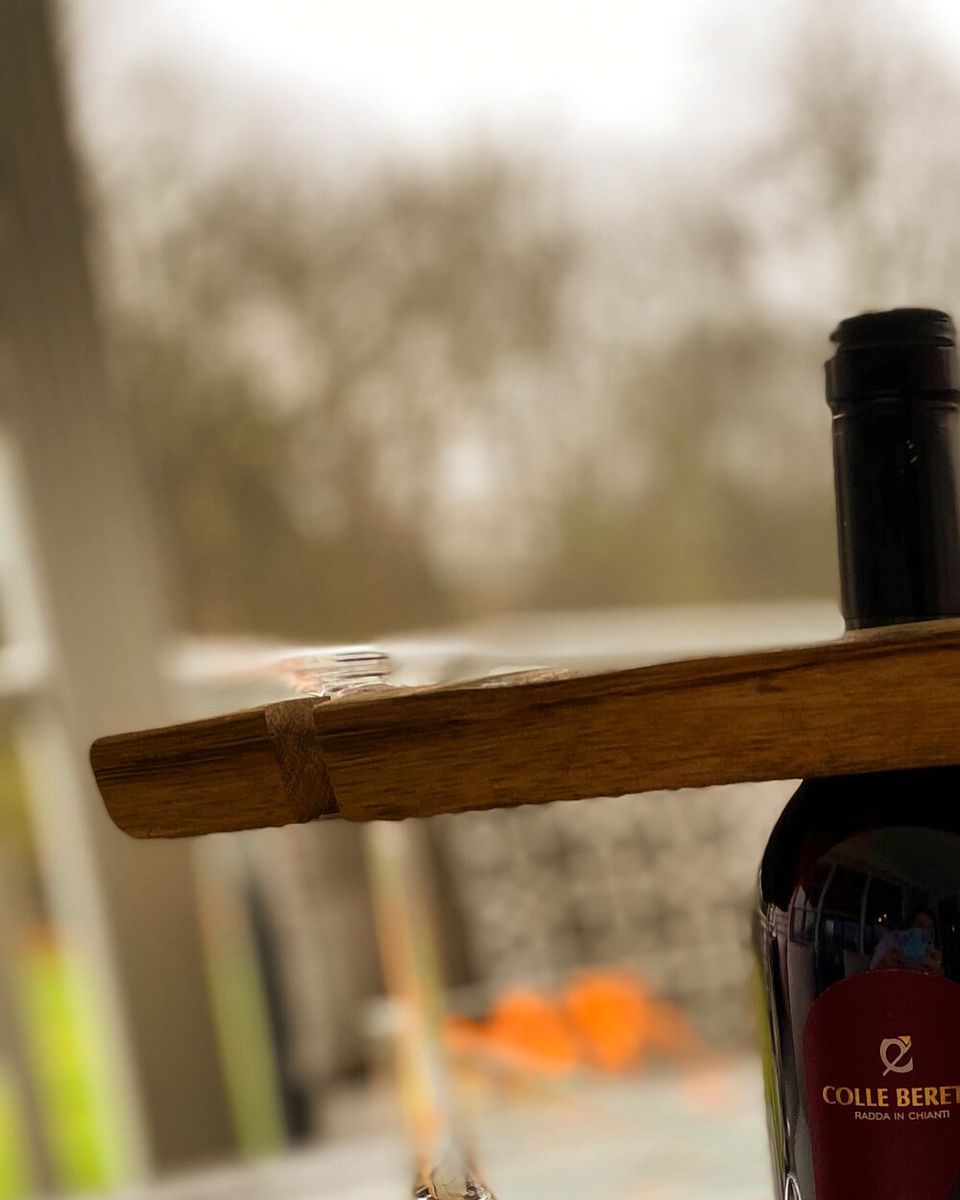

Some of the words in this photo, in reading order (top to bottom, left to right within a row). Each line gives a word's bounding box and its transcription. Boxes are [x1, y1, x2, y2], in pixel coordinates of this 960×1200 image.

[822, 1085, 889, 1107] COLLE
[854, 1111, 891, 1121] RADDA
[894, 1111, 905, 1121] IN
[908, 1110, 950, 1121] CHIANTI
